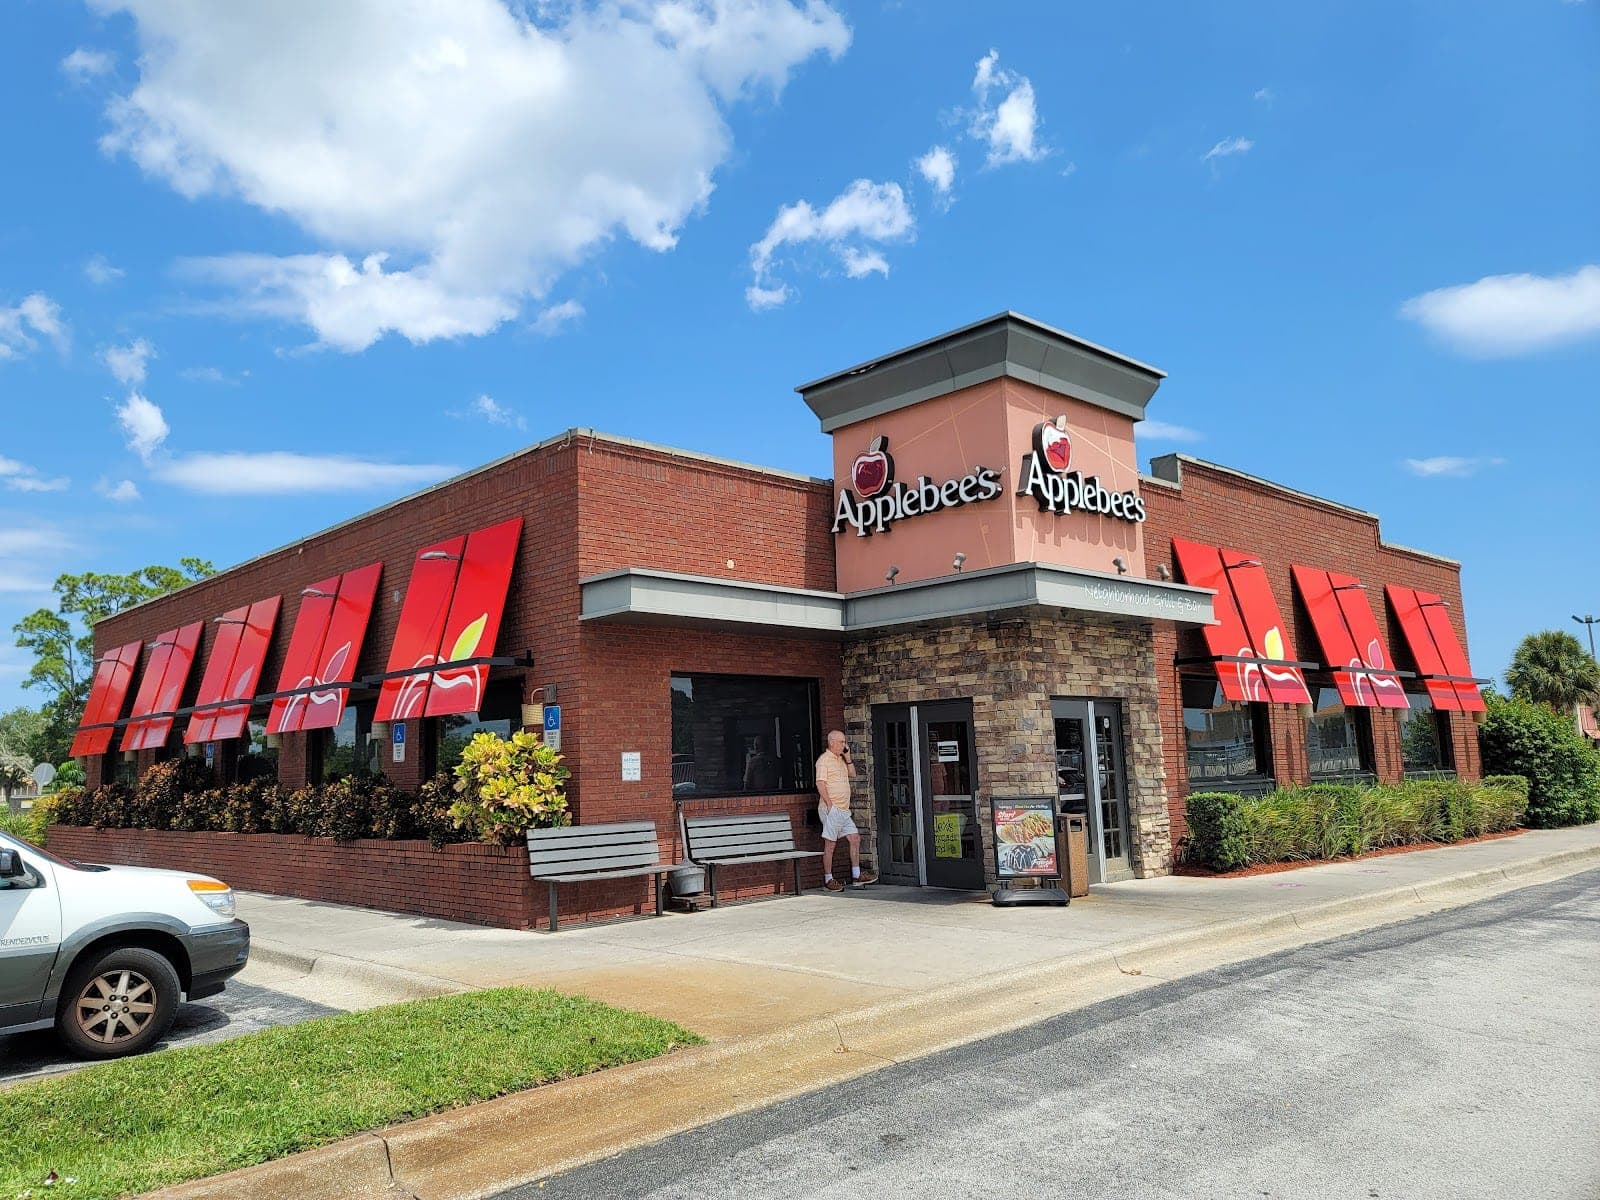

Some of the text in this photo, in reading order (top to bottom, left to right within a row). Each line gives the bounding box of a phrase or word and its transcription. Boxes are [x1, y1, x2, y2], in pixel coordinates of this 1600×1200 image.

[831, 465, 1003, 537] Applebee's
[1024, 451, 1146, 523] Applebee's
[1084, 583, 1151, 606] Neighborhood
[0, 934, 49, 946] RENDEZVOUS
